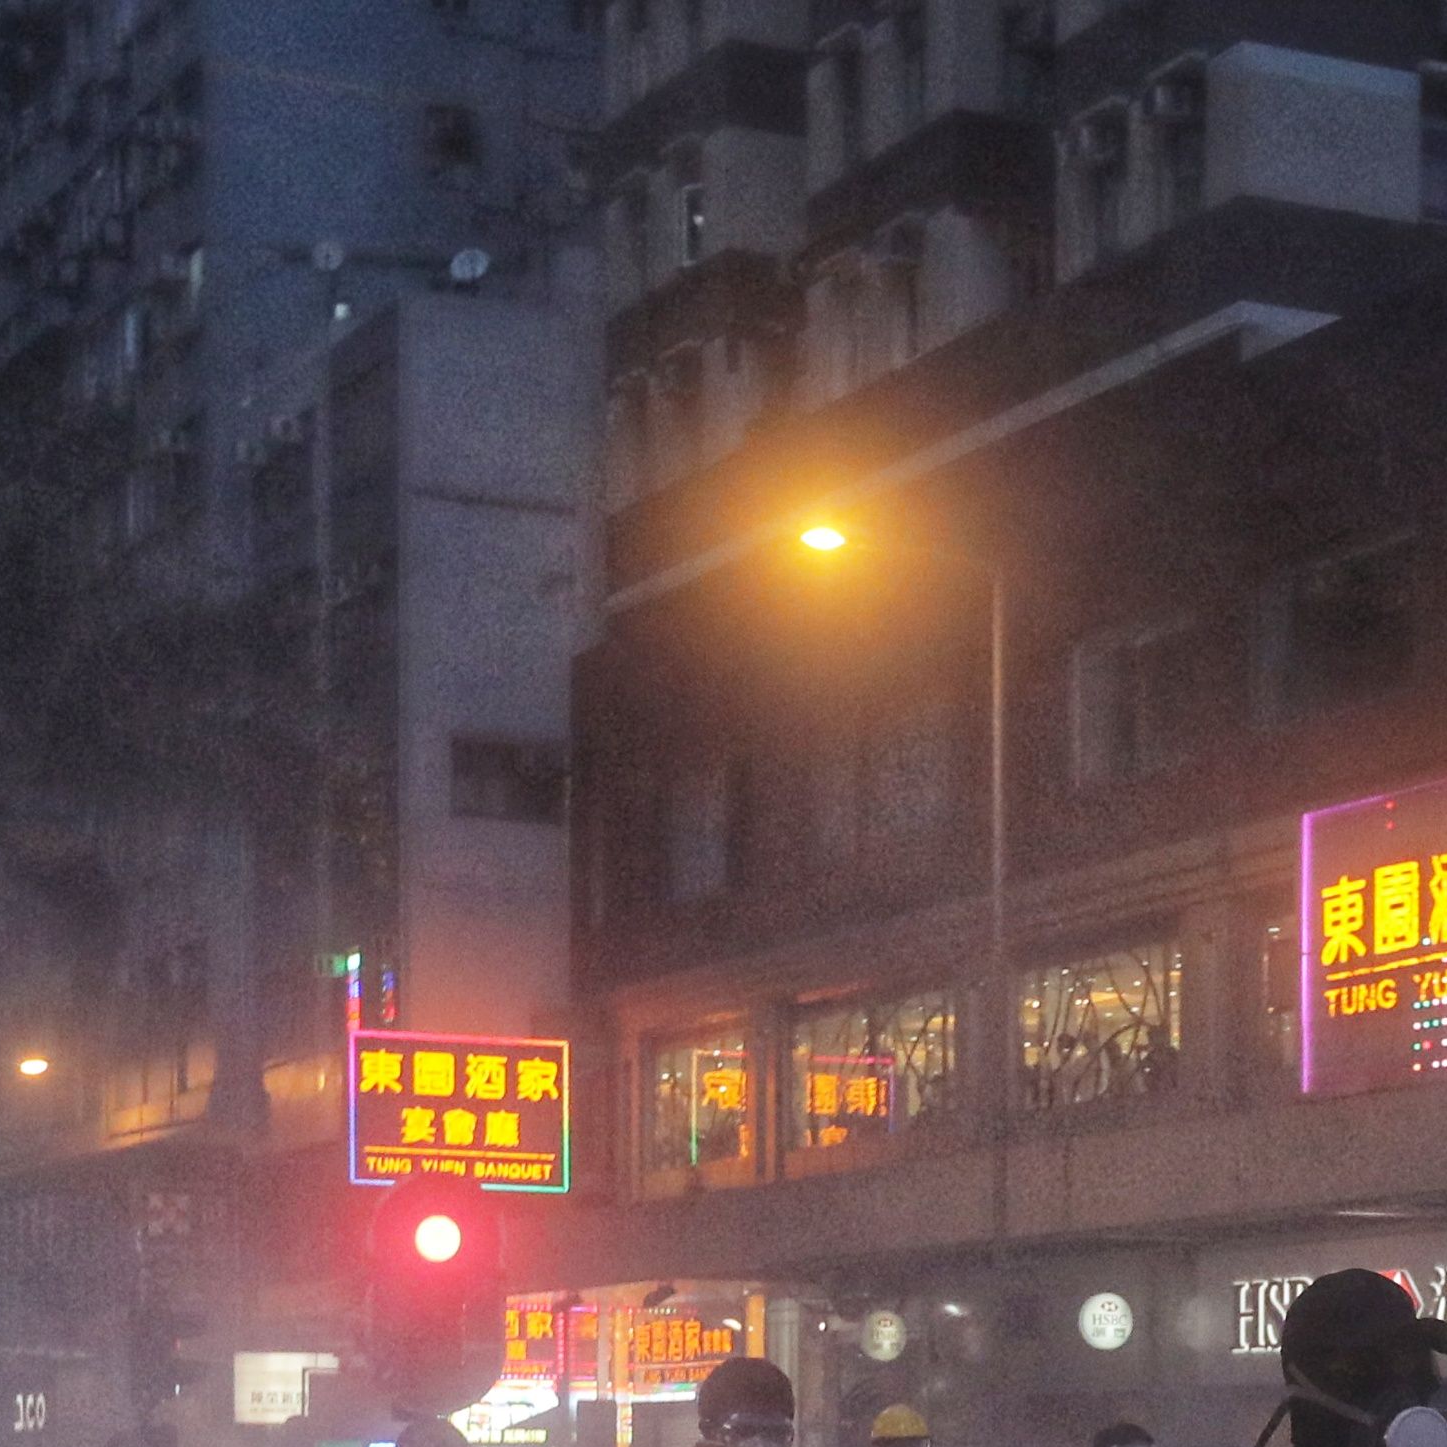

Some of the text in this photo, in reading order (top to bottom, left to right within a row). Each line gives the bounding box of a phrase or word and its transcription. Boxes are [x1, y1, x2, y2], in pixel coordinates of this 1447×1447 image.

[1324, 979, 1397, 1017] TUNG
[360, 1049, 559, 1102] 東園酒家
[365, 1156, 553, 1181] TUNG YUEN BANQUET
[1092, 1313, 1129, 1326] HSBC
